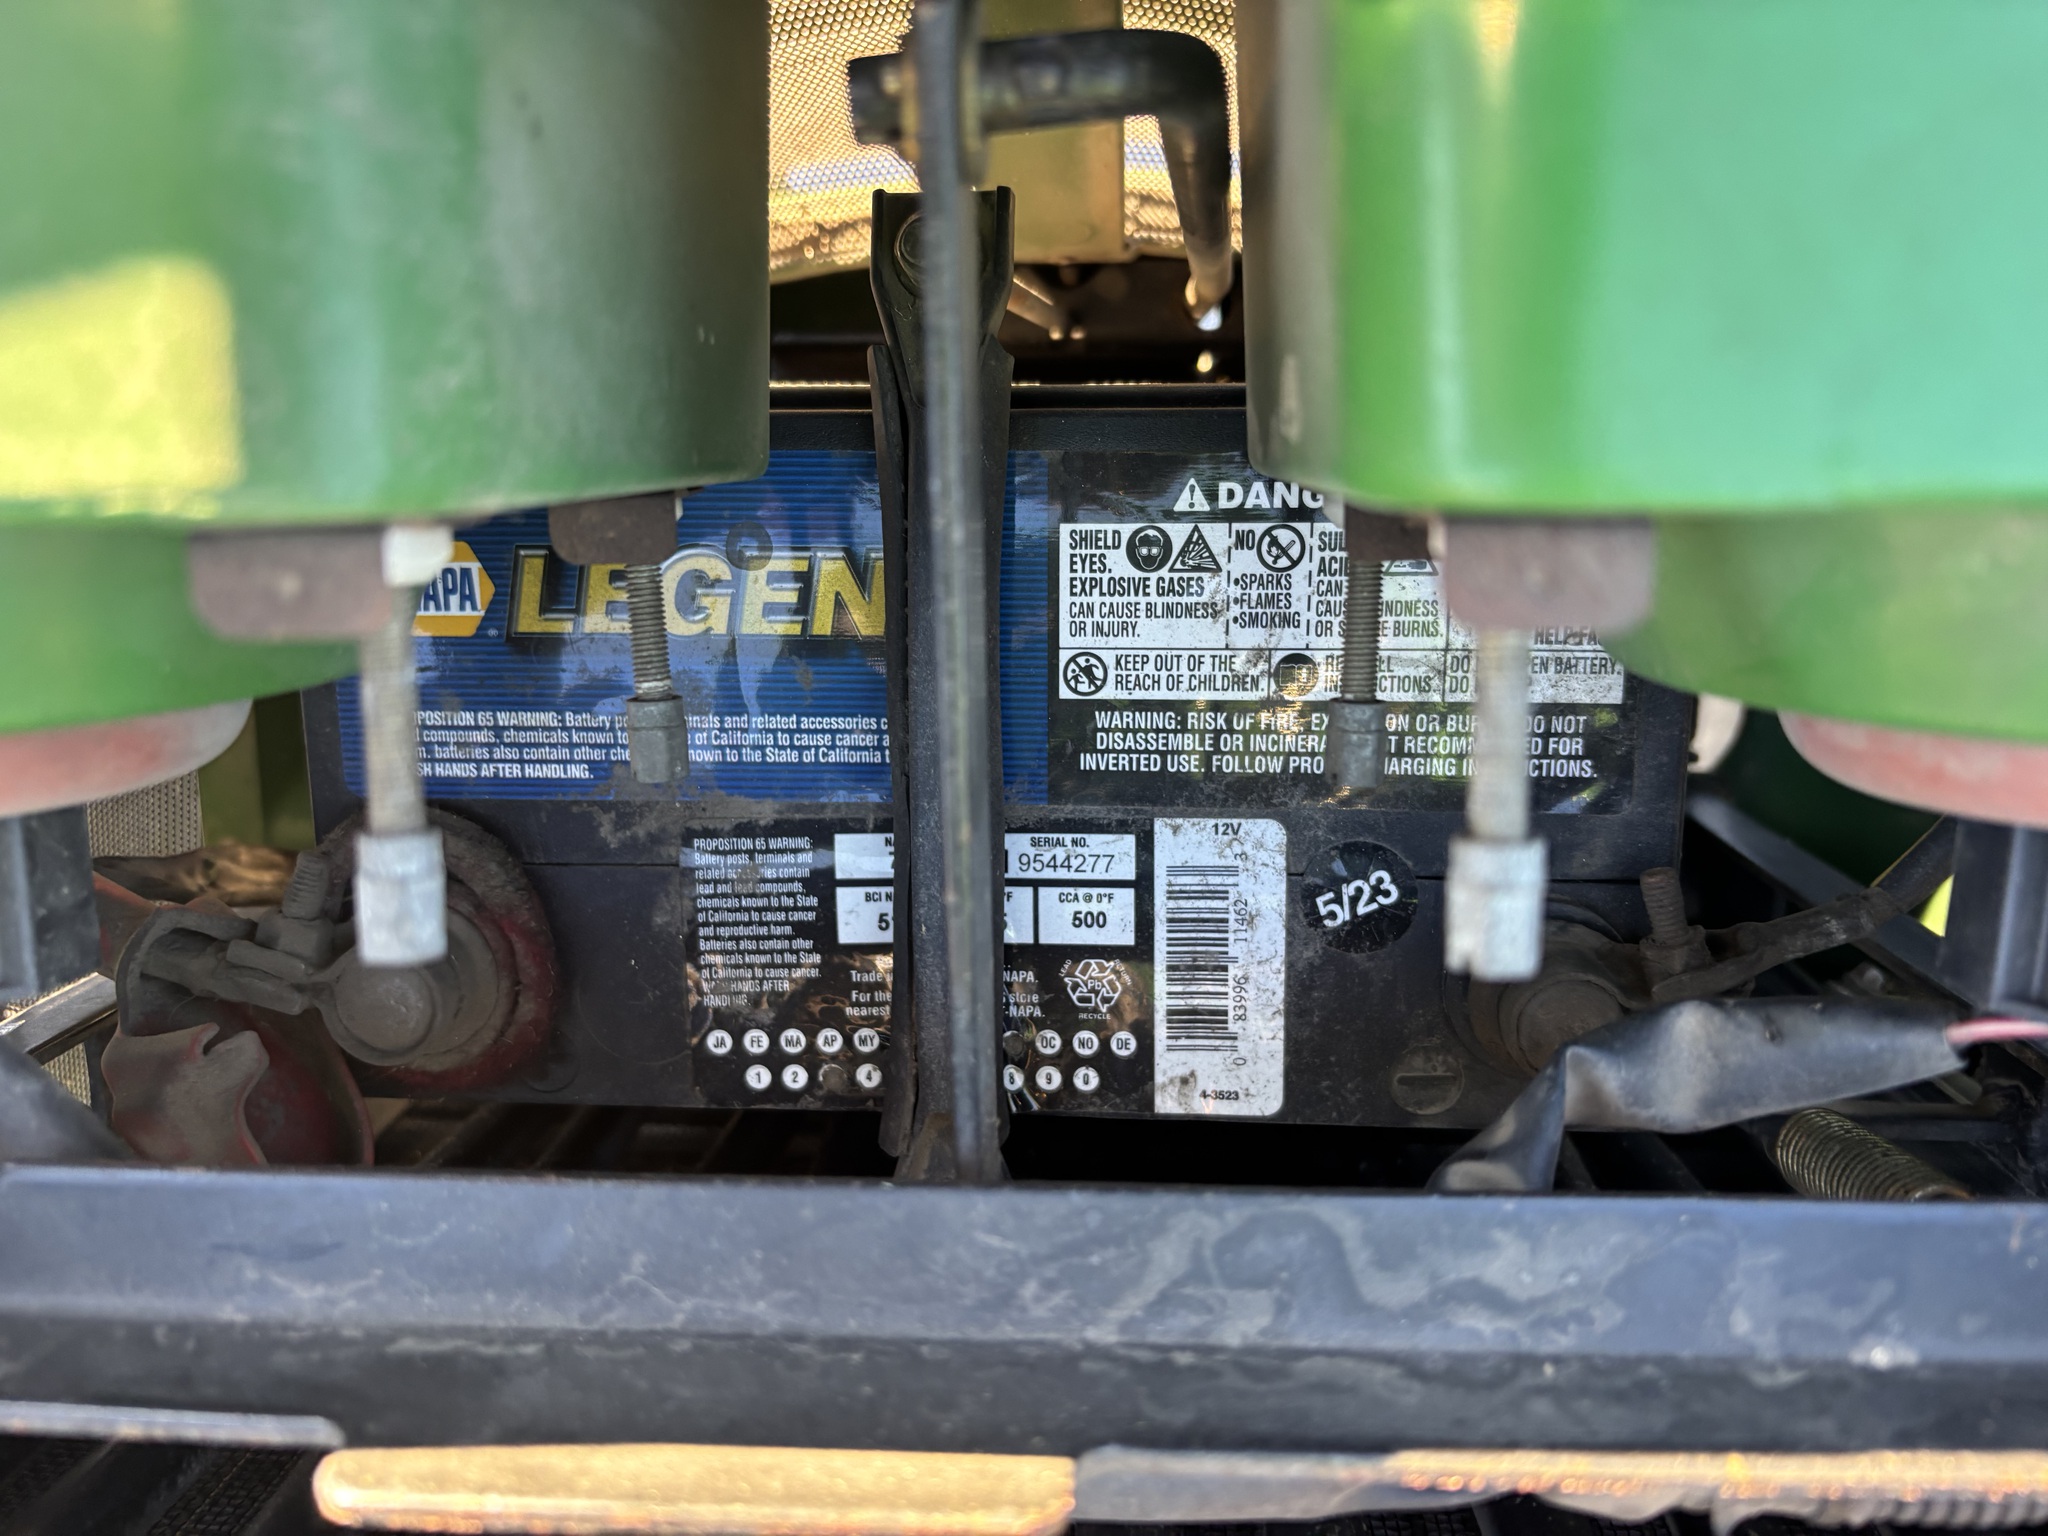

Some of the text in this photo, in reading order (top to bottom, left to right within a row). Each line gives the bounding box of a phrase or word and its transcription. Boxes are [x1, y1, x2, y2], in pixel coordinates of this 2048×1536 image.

[1218, 481, 1324, 510] DANG
[1069, 529, 1121, 551] SHIELD
[1234, 530, 1256, 551] NO
[1069, 553, 1112, 574] EYES.
[421, 567, 479, 612] APA
[510, 543, 888, 638] LEGEN
[1069, 577, 1205, 597] EXPLOSIVE GASES
[1316, 580, 1343, 597] CAN
[1069, 602, 1219, 619] CAN CAUSE BLINDNESS
[1069, 621, 1141, 638] OR INJURY.
[1315, 620, 1333, 637] OR
[1393, 620, 1443, 637] BURNS.
[1115, 655, 1236, 672] KEEP OUT OF THE
[1450, 655, 1471, 673] DO
[1115, 674, 1265, 692] REACH OF CHILDREN.
[1450, 676, 1470, 693] DO
[478, 711, 494, 726] 65
[498, 711, 562, 727] WARNING:
[566, 712, 611, 730] Battery
[724, 714, 748, 728] and
[752, 714, 796, 729] related
[801, 714, 877, 730] accessories
[1095, 711, 1181, 730] WARNING:
[1187, 712, 1227, 730] RISK
[1233, 712, 1254, 730] OF
[1260, 713, 1304, 732] FIRE,
[1416, 714, 1440, 731] OR
[1551, 716, 1587, 733] NOT
[423, 729, 500, 747] compounds,
[503, 728, 569, 744] chemicals
[572, 729, 614, 744] known
[617, 730, 629, 744] to
[695, 730, 708, 745] of
[711, 730, 773, 746] California
[778, 731, 790, 746] to
[794, 733, 832, 746] cause
[835, 733, 879, 747] cancer
[1096, 732, 1214, 751] DISASSEMBLE
[1220, 733, 1244, 752] OR
[1548, 737, 1583, 756] FOR
[434, 744, 490, 759] batteries
[493, 745, 519, 760] also
[523, 746, 570, 760] contain
[574, 746, 607, 761] other
[688, 749, 723, 762] nown
[726, 748, 739, 762] to
[742, 748, 762, 762] the
[766, 748, 799, 763] State
[803, 748, 816, 763] of
[819, 748, 882, 764] California
[435, 763, 478, 778] HANDS
[481, 763, 522, 778] AFTER
[525, 763, 594, 779] HANDLING.
[1080, 753, 1161, 771] INVERTED
[1166, 754, 1205, 772] USE.
[1212, 755, 1283, 773] FOLLOW
[1384, 757, 1456, 776] ARGING
[1212, 822, 1242, 836] 12V
[694, 837, 813, 851] PROPOSITION 65 WARNING:
[1030, 836, 1090, 848] SERIAL NO.
[695, 853, 724, 866] Battery
[755, 851, 795, 864] terminals
[797, 851, 813, 863] and
[1018, 853, 1115, 873] 9544277
[695, 867, 725, 879] related
[779, 867, 810, 878] contain
[696, 882, 715, 894] lead
[717, 882, 732, 893] and
[697, 895, 819, 908] chemicals known to the State
[865, 891, 882, 903] BCI
[1059, 892, 1079, 903] CCA
[1315, 869, 1399, 927] 5/23
[698, 910, 816, 922] of California to cause cancer
[1071, 911, 1107, 928] 500
[1233, 898, 1248, 943] 11462
[699, 924, 795, 938] and reproductive harm.
[700, 938, 814, 951] Batteries also contain other
[700, 951, 821, 965] chemicals known to the State
[712, 966, 752, 978] California
[754, 967, 763, 978] to
[765, 968, 789, 978] cause
[791, 967, 822, 978] cancer.
[850, 970, 883, 983] Trade
[731, 980, 760, 992] HANDS
[763, 980, 790, 991] AFTER
[1087, 980, 1102, 990] Pb
[852, 990, 892, 1002] For the
[846, 1005, 891, 1016] nearest
[713, 1034, 1131, 1050] JA FE MA AP MY OC NO DE
[792, 1071, 798, 1083] 2
[866, 1070, 872, 1082] 4
[1046, 1072, 1052, 1084] 9
